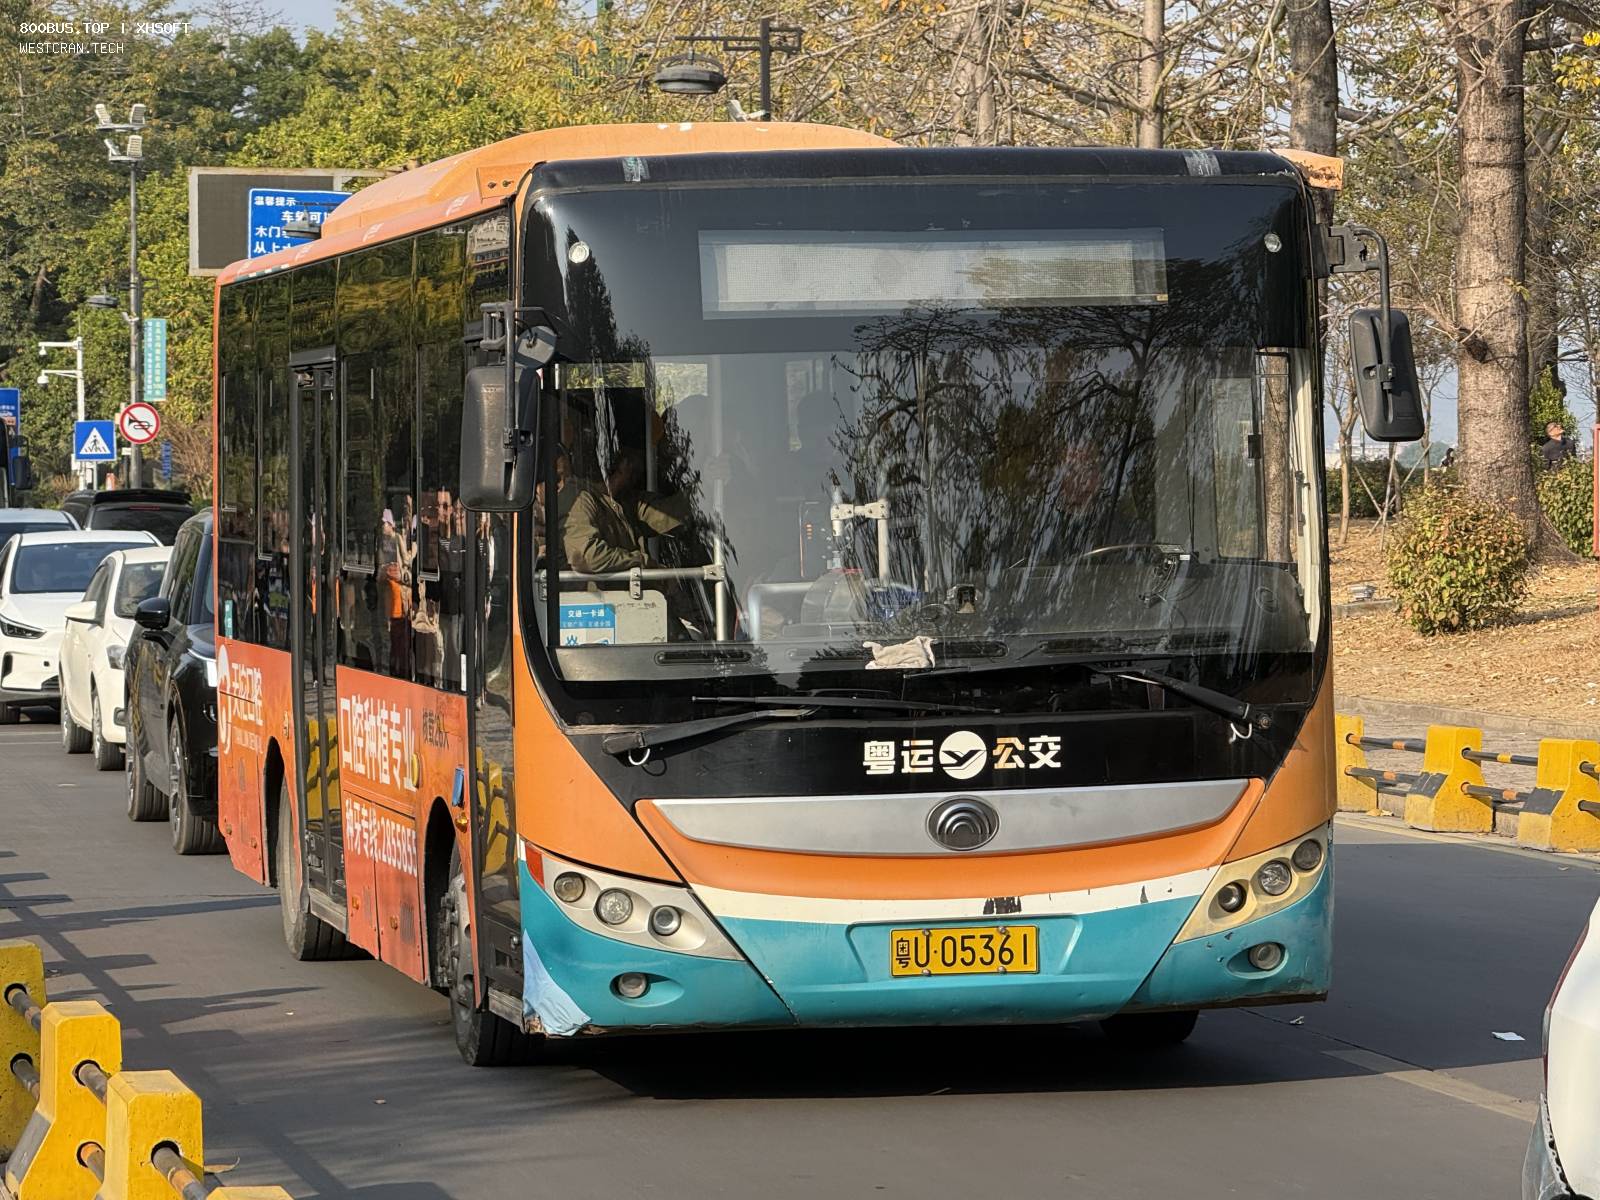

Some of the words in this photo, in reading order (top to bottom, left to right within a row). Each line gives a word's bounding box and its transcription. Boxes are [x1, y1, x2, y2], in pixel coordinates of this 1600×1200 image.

[255, 225, 289, 239] 木门
[567, 608, 605, 618] 交通一卡通
[339, 695, 417, 793] 口腔种植专业
[862, 739, 934, 775] 粤运
[992, 735, 1062, 770] 公交
